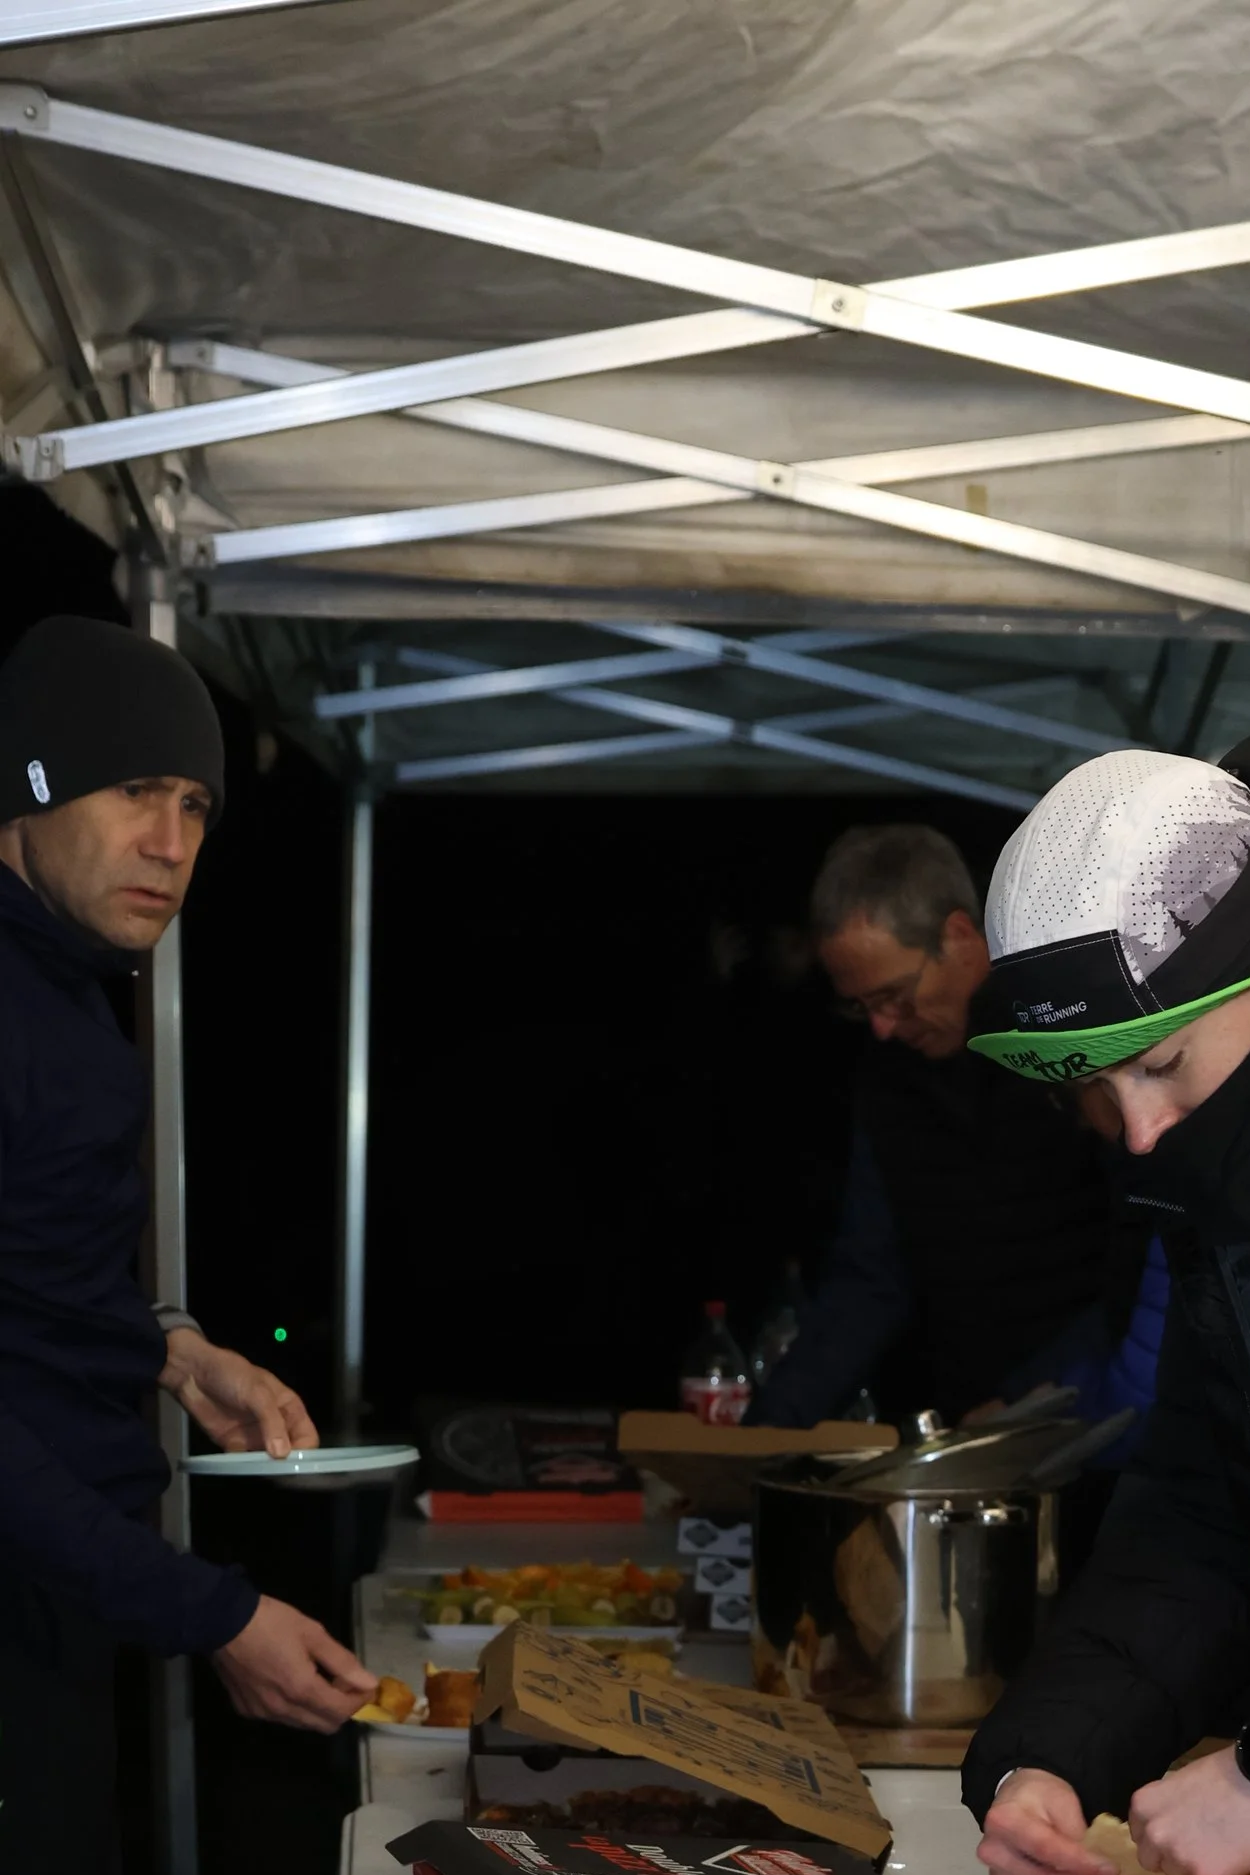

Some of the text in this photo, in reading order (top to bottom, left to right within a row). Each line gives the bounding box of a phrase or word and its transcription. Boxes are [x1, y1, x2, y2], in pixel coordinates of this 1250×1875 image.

[1030, 1001, 1054, 1015] TERRE
[1044, 1001, 1088, 1024] RUNNING
[1002, 1050, 1042, 1070] TEAM
